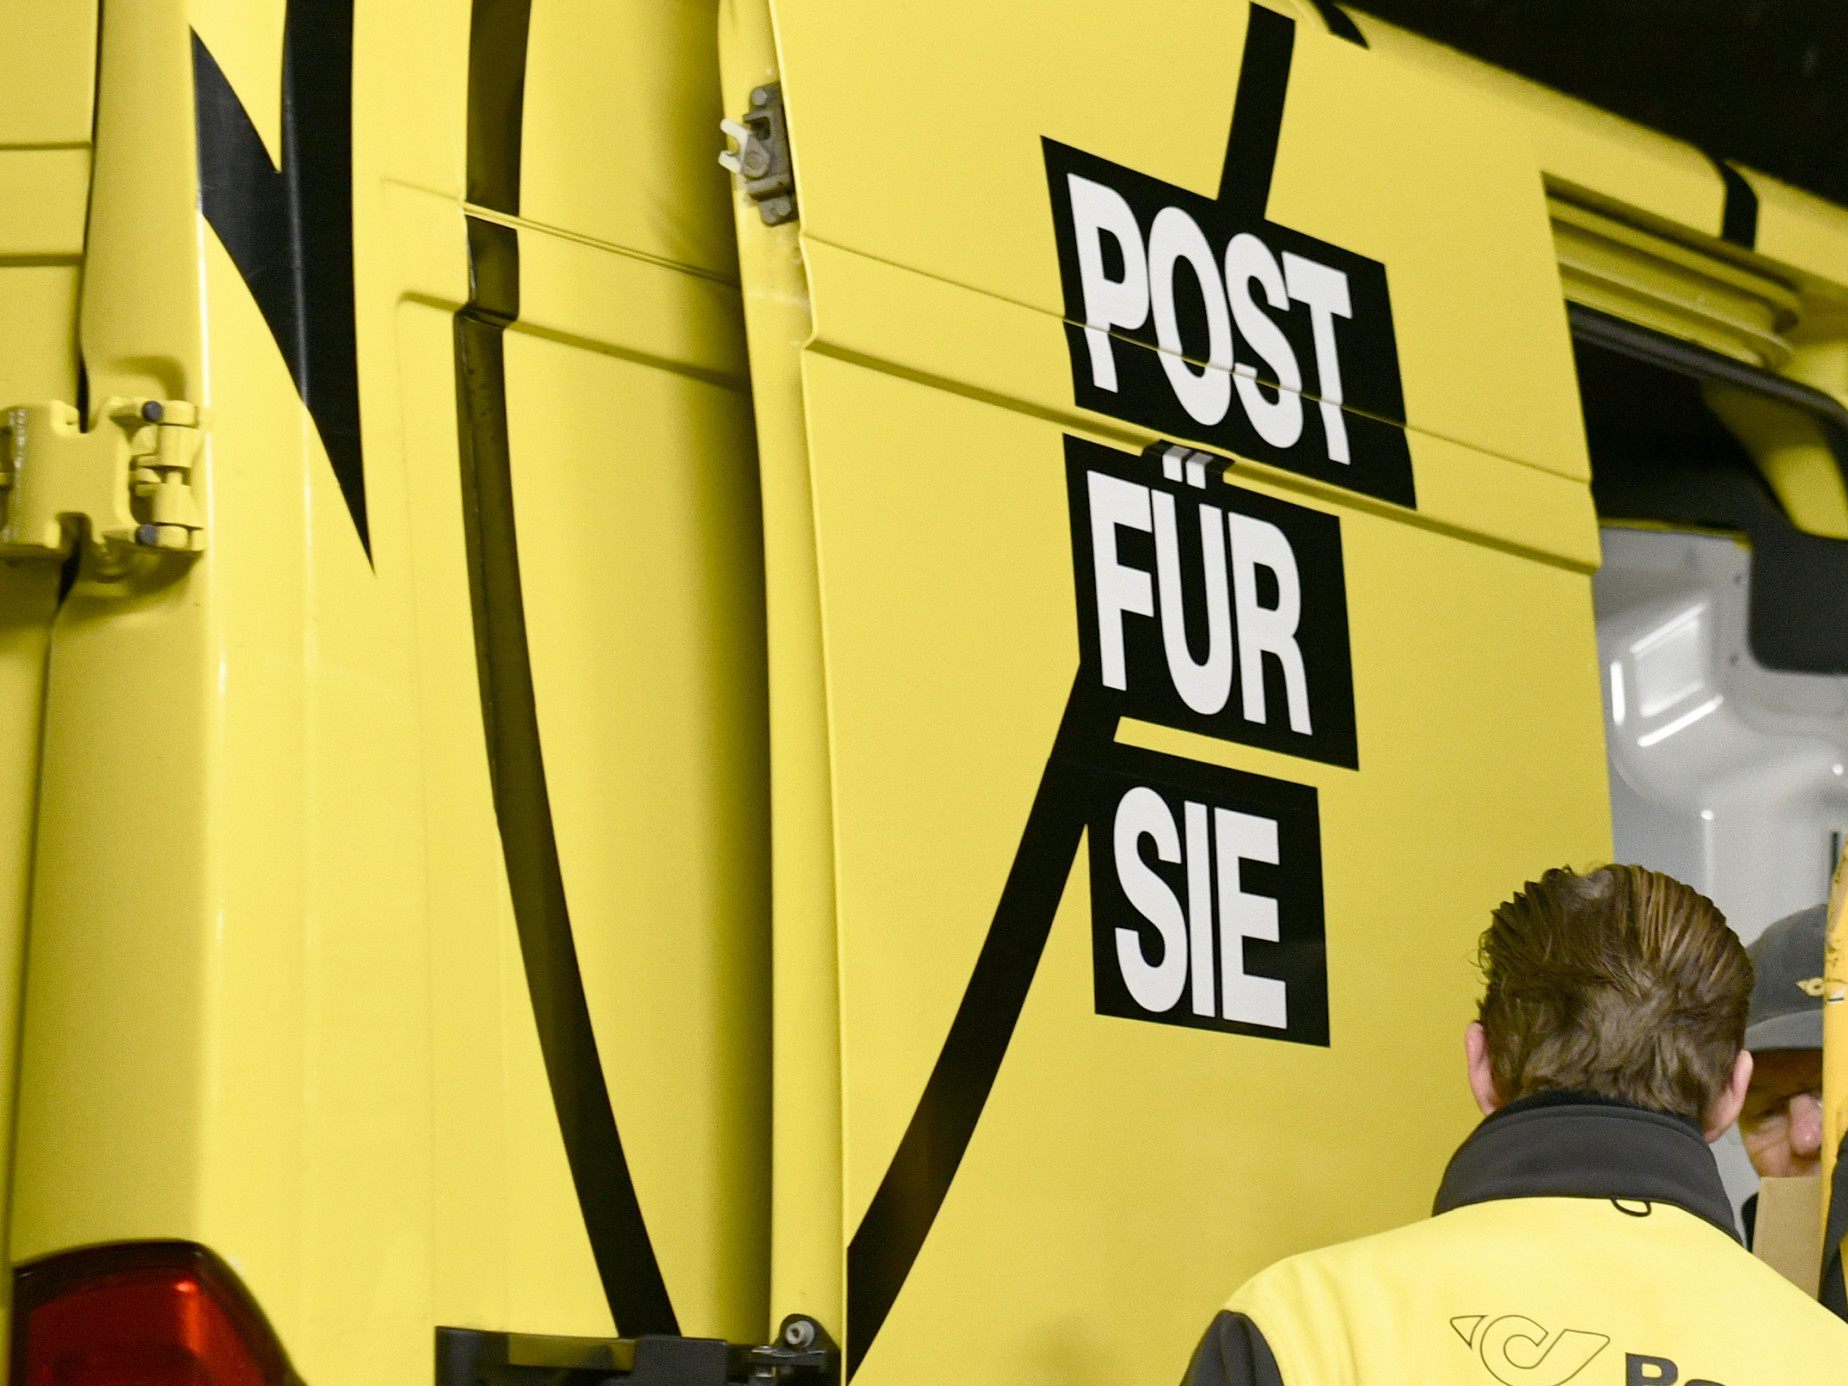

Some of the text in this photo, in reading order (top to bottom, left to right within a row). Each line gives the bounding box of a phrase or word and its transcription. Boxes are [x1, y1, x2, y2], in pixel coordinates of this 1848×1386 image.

[1068, 172, 1353, 466] POST
[1086, 444, 1313, 736] FÜR
[1112, 786, 1288, 1030] SIE
